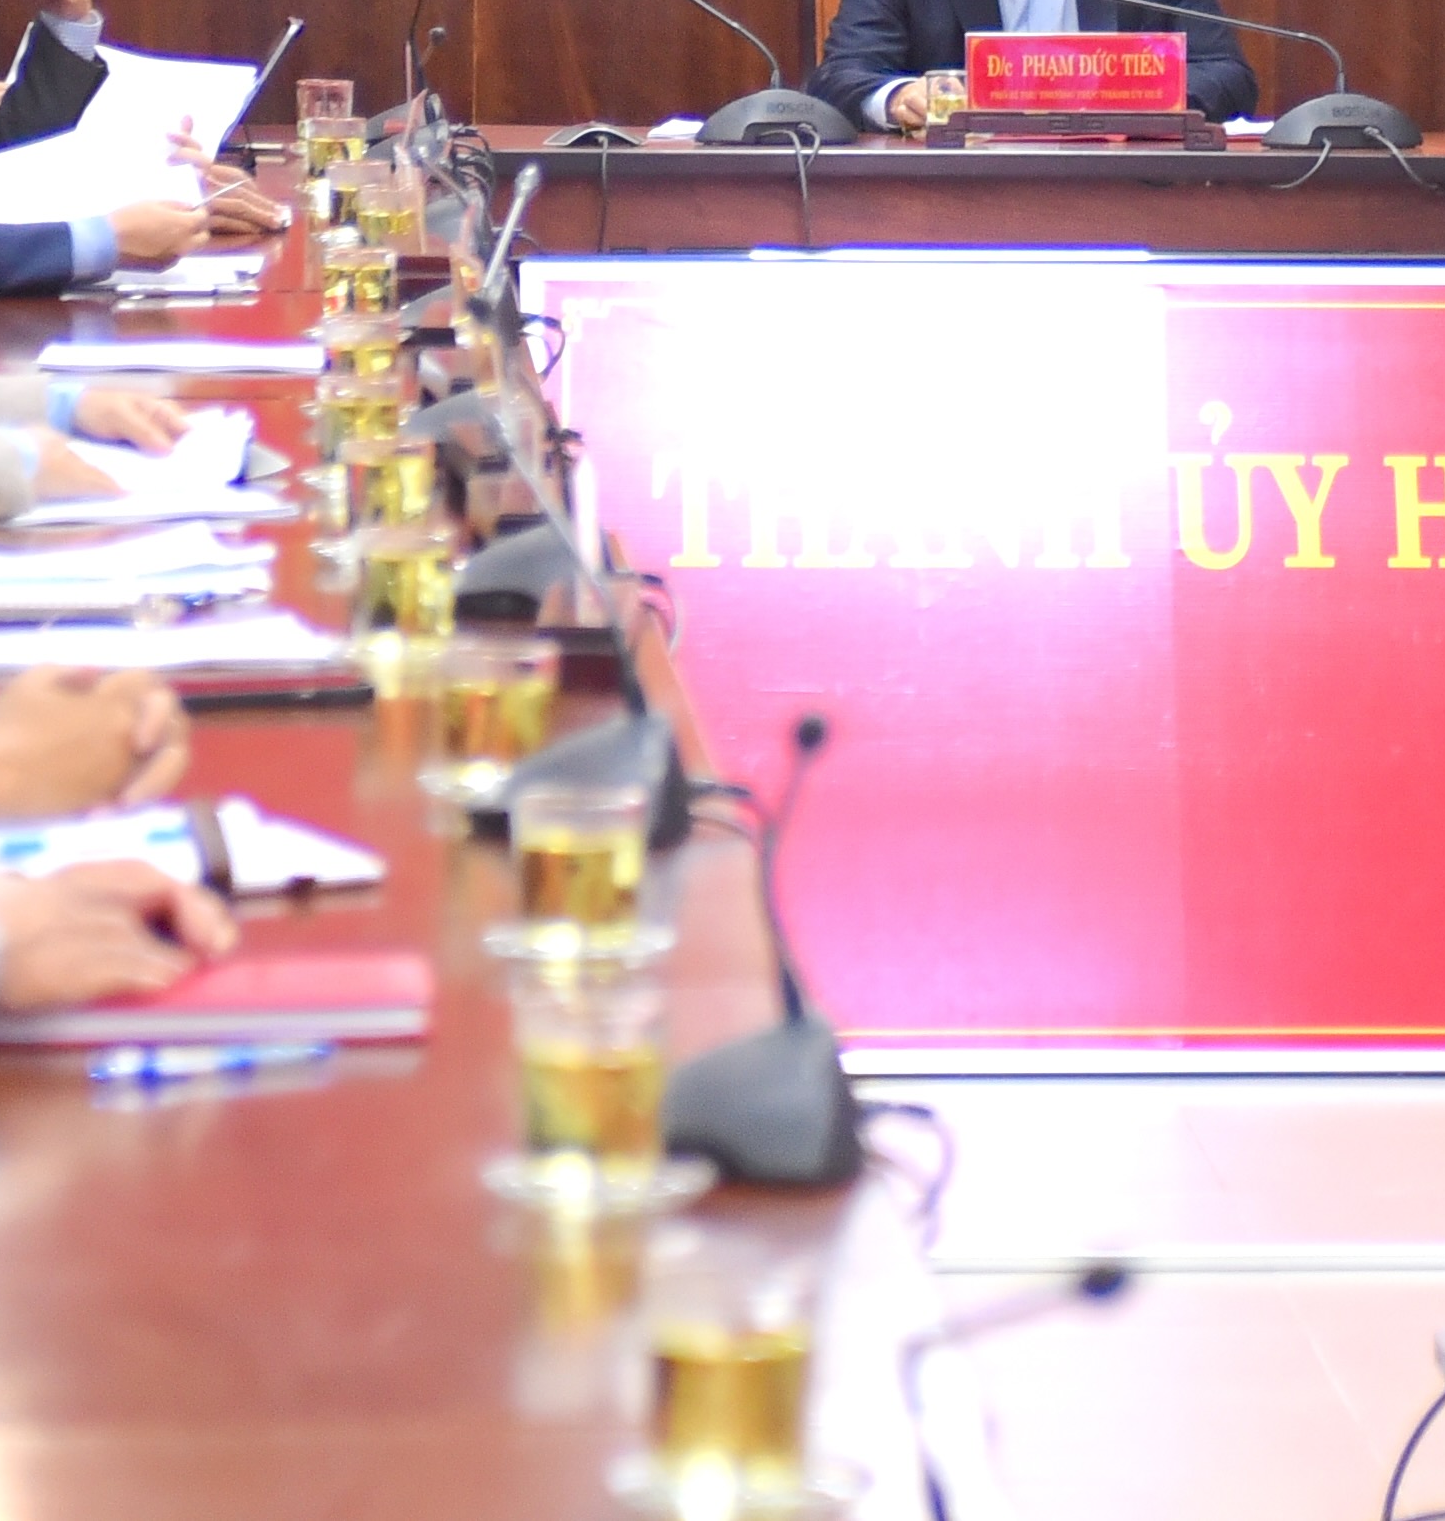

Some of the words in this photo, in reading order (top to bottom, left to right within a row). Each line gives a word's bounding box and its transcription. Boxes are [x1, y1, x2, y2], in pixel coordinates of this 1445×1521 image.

[986, 54, 1013, 77] Đ/c
[1022, 54, 1075, 81] PHẠM
[1079, 48, 1117, 77] ĐỨC
[1120, 44, 1165, 77] TIẾN
[1166, 400, 1350, 571] ỦY
